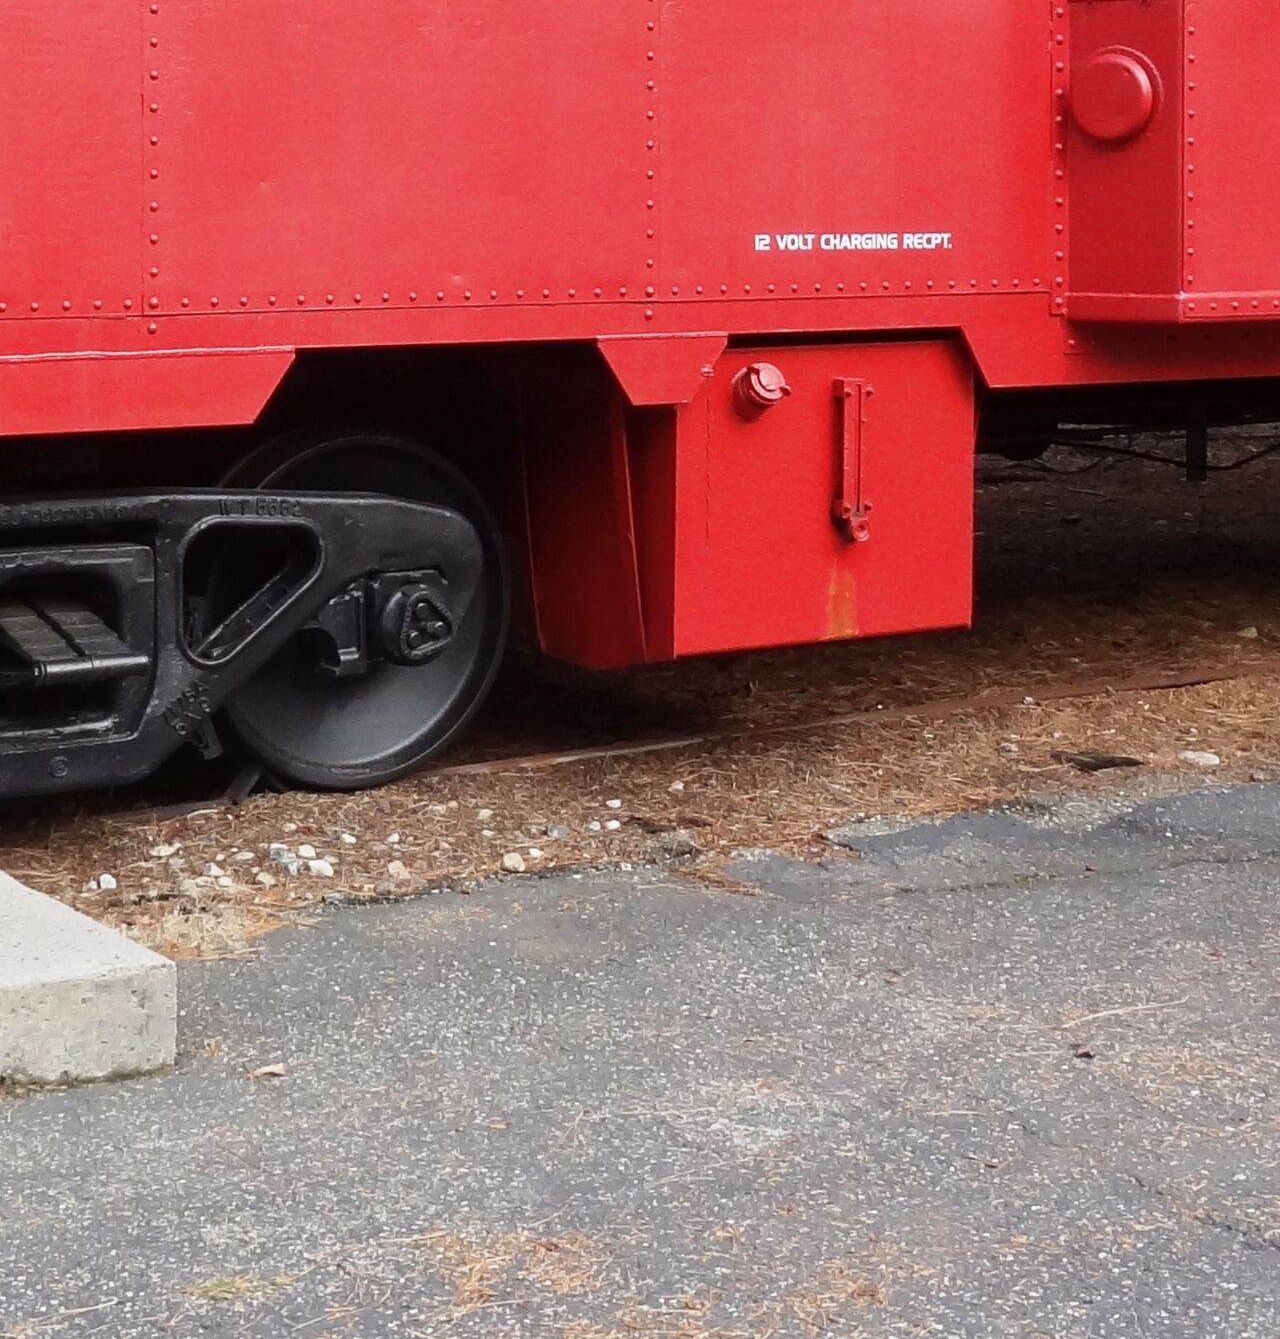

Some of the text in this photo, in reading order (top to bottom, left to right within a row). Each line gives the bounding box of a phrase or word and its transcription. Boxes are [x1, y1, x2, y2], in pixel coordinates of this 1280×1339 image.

[754, 232, 953, 251] 12 VOLT CHARGING RECPT.
